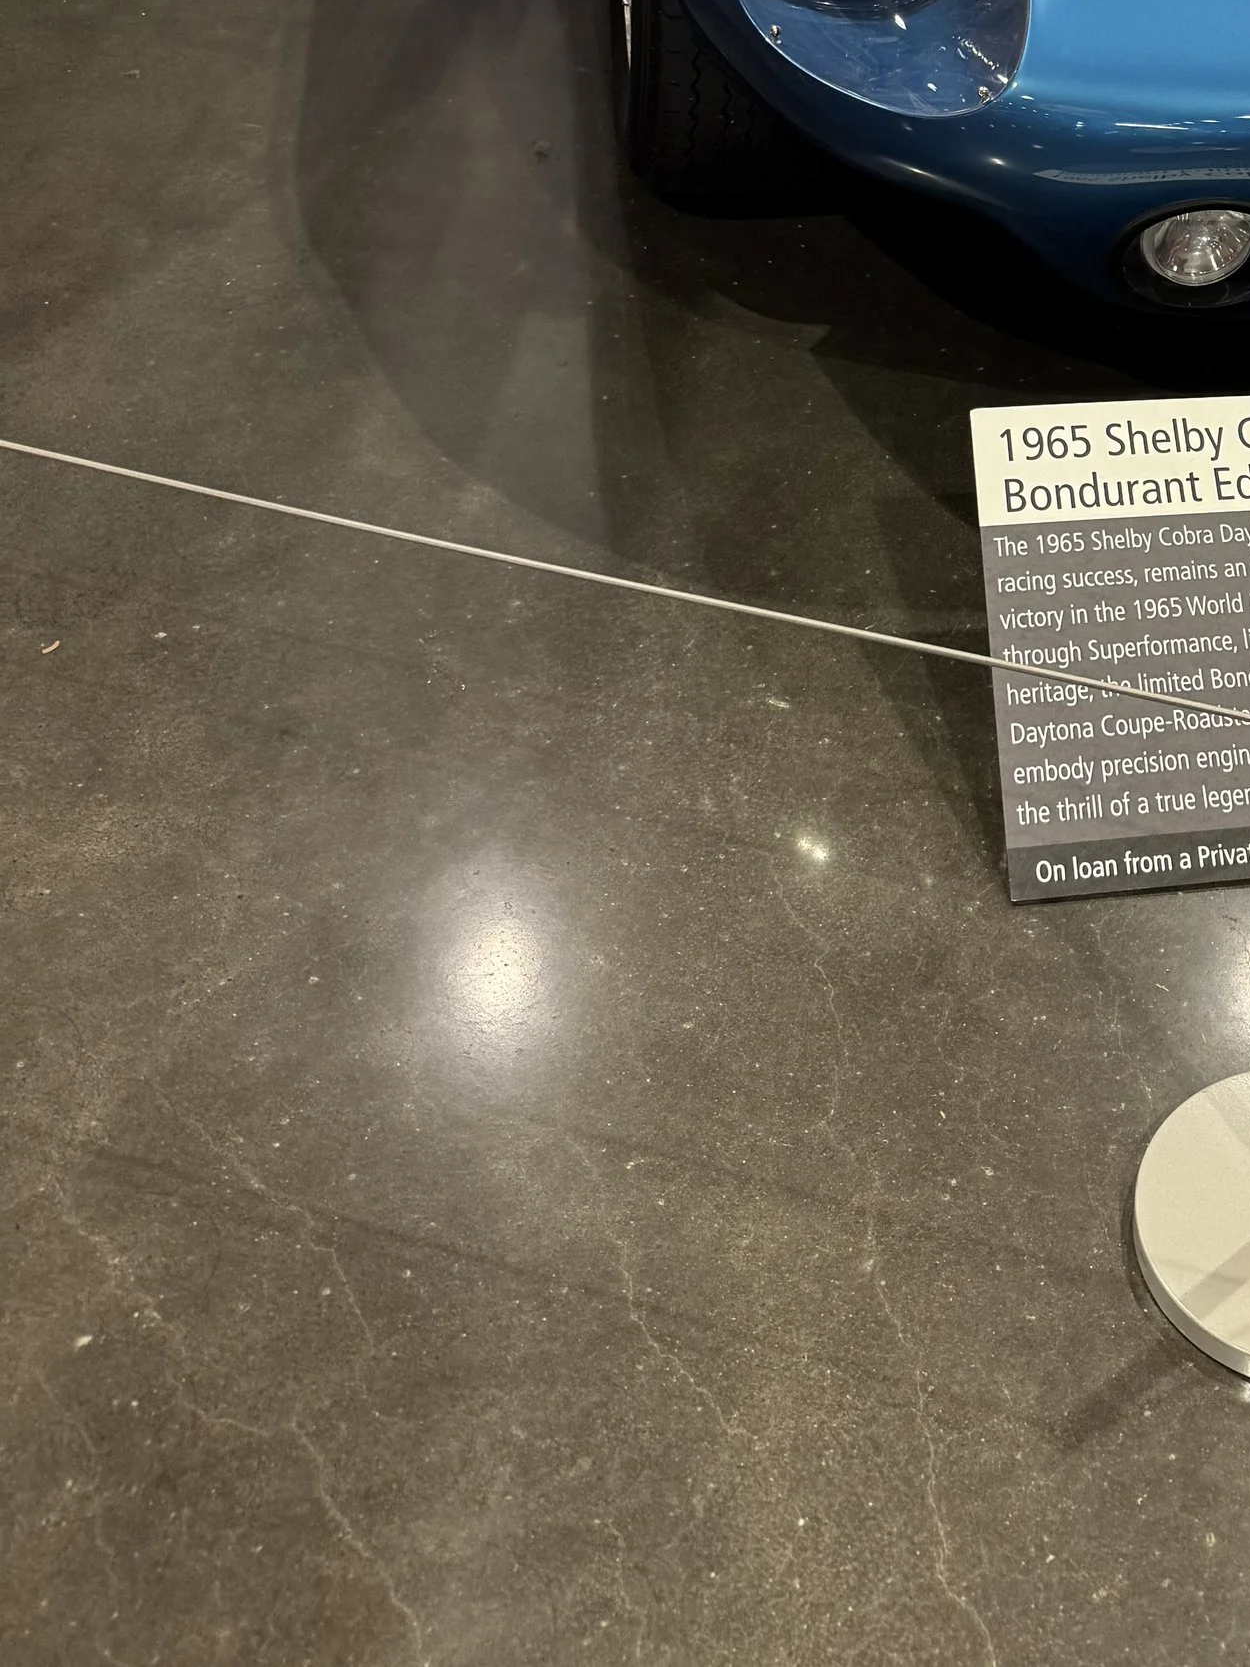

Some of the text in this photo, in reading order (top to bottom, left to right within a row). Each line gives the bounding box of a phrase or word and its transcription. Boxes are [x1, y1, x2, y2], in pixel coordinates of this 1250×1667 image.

[999, 424, 1092, 463] 1965
[1104, 417, 1224, 462] Shelby
[1003, 470, 1204, 514] Bondurant
[992, 535, 1029, 558] The
[1035, 531, 1086, 555] 1965
[1090, 527, 1153, 554] Shelby
[1157, 523, 1215, 547] Cobra
[997, 570, 1057, 596] racing
[1062, 568, 1139, 589] success,
[1143, 559, 1219, 583] remains
[1223, 561, 1248, 578] an
[998, 607, 1065, 632] victory
[1069, 603, 1089, 625] in
[1093, 599, 1126, 624] the
[1133, 596, 1183, 621] 1965
[1184, 591, 1245, 617] World
[1002, 639, 1082, 669] through
[1087, 633, 1238, 666] Superformance,
[1006, 680, 1094, 707] heritage,
[1137, 667, 1205, 694] limited
[1010, 721, 1095, 750] Daytona
[1013, 758, 1095, 786] embody
[1101, 749, 1191, 780] precision
[1015, 799, 1051, 826] the
[1055, 793, 1104, 823] thrill
[1109, 790, 1131, 818] of
[1137, 796, 1150, 815] a
[1154, 792, 1197, 813] true
[1035, 859, 1067, 884] On
[1071, 855, 1119, 881] loan
[1122, 849, 1174, 876] from
[1178, 851, 1193, 870] a
